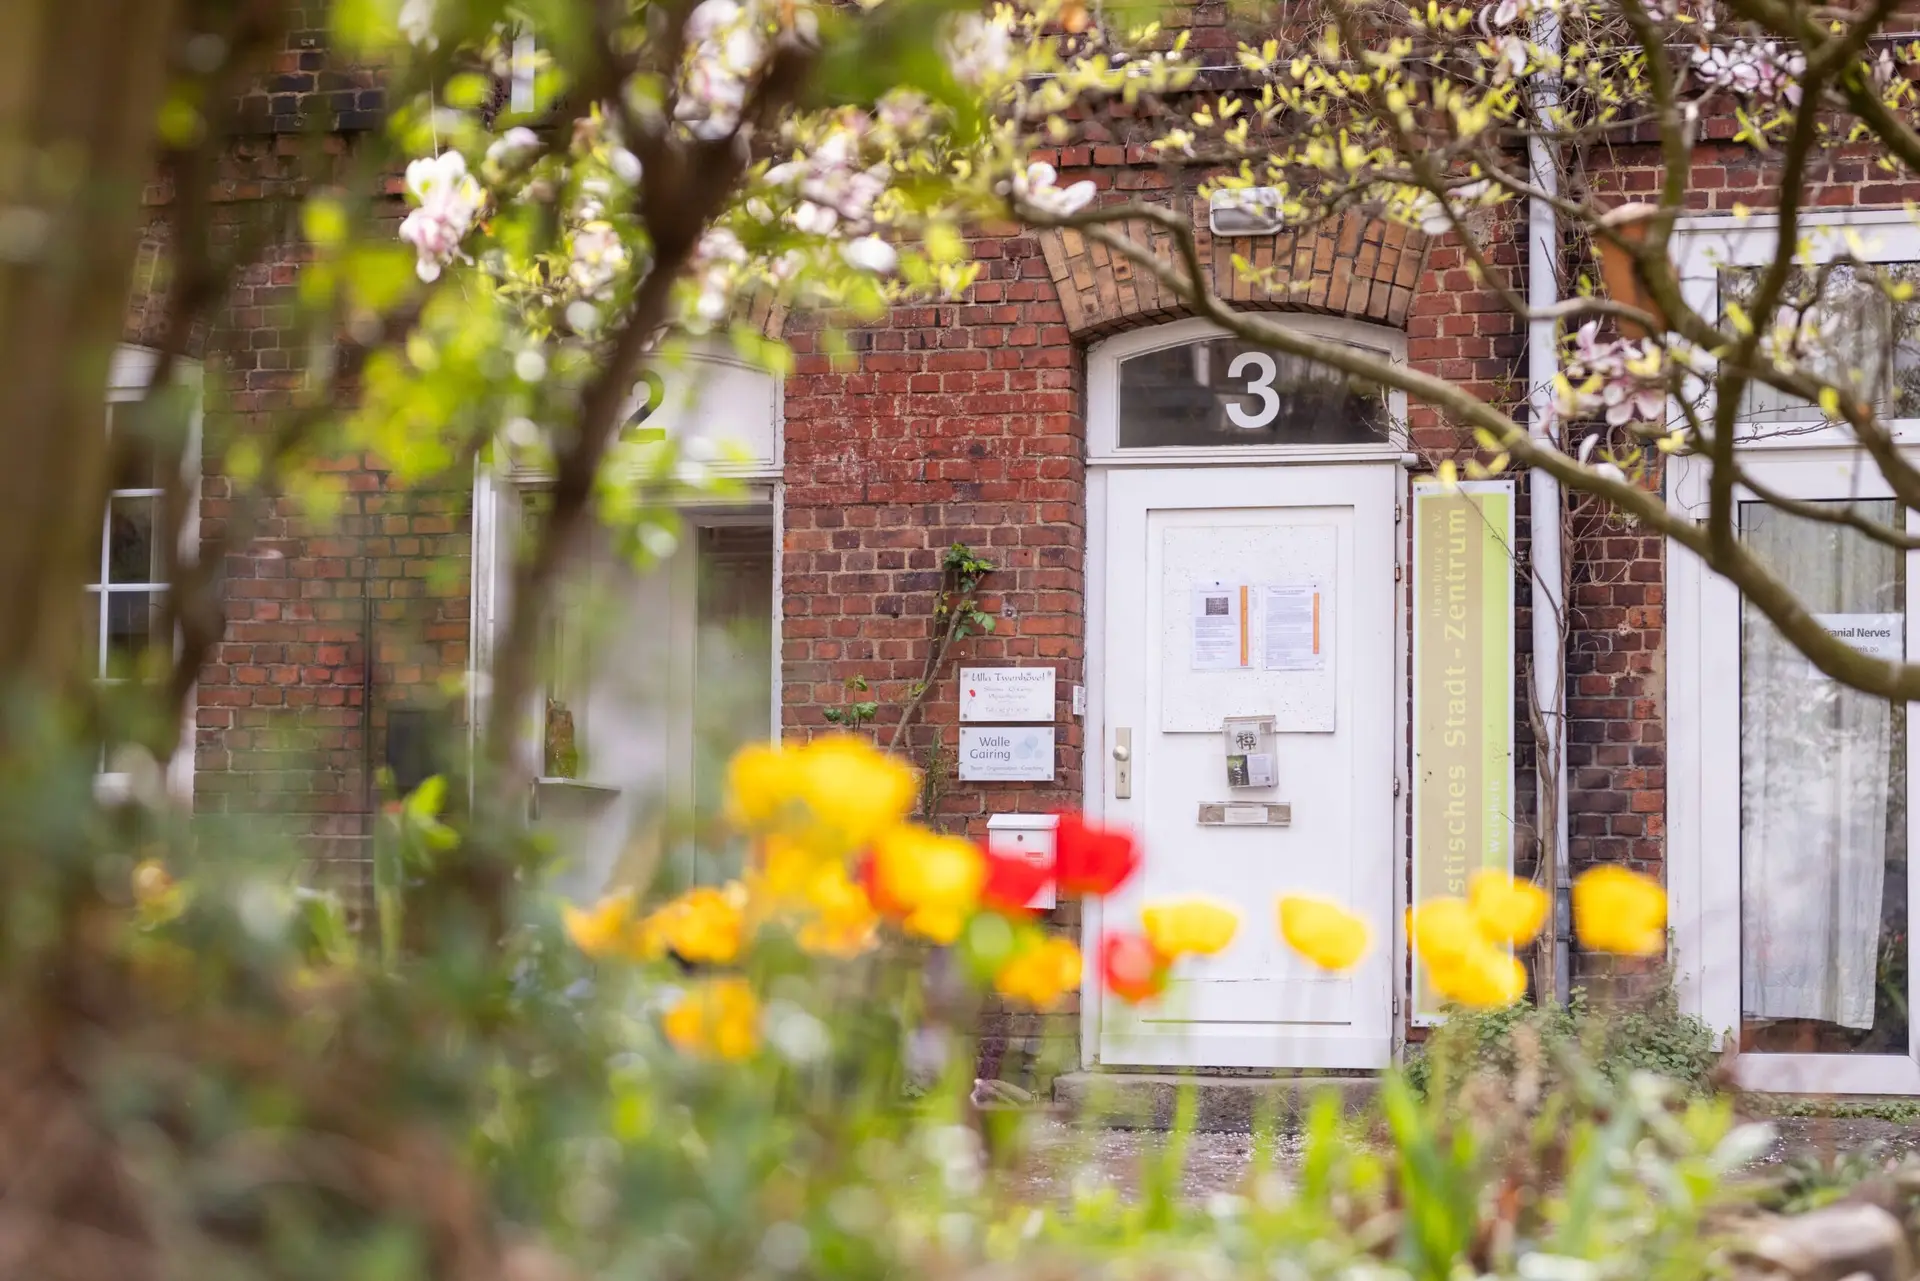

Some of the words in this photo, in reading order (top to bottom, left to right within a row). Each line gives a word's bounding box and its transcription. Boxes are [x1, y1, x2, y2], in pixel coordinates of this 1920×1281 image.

[618, 368, 666, 443] 2
[1225, 351, 1280, 429] 3
[1432, 546, 1444, 617] Hamburg
[1856, 628, 1891, 638] Nerves
[969, 748, 1011, 762] Gairing
[979, 735, 1010, 747] Walle
[1443, 764, 1466, 893] stisches
